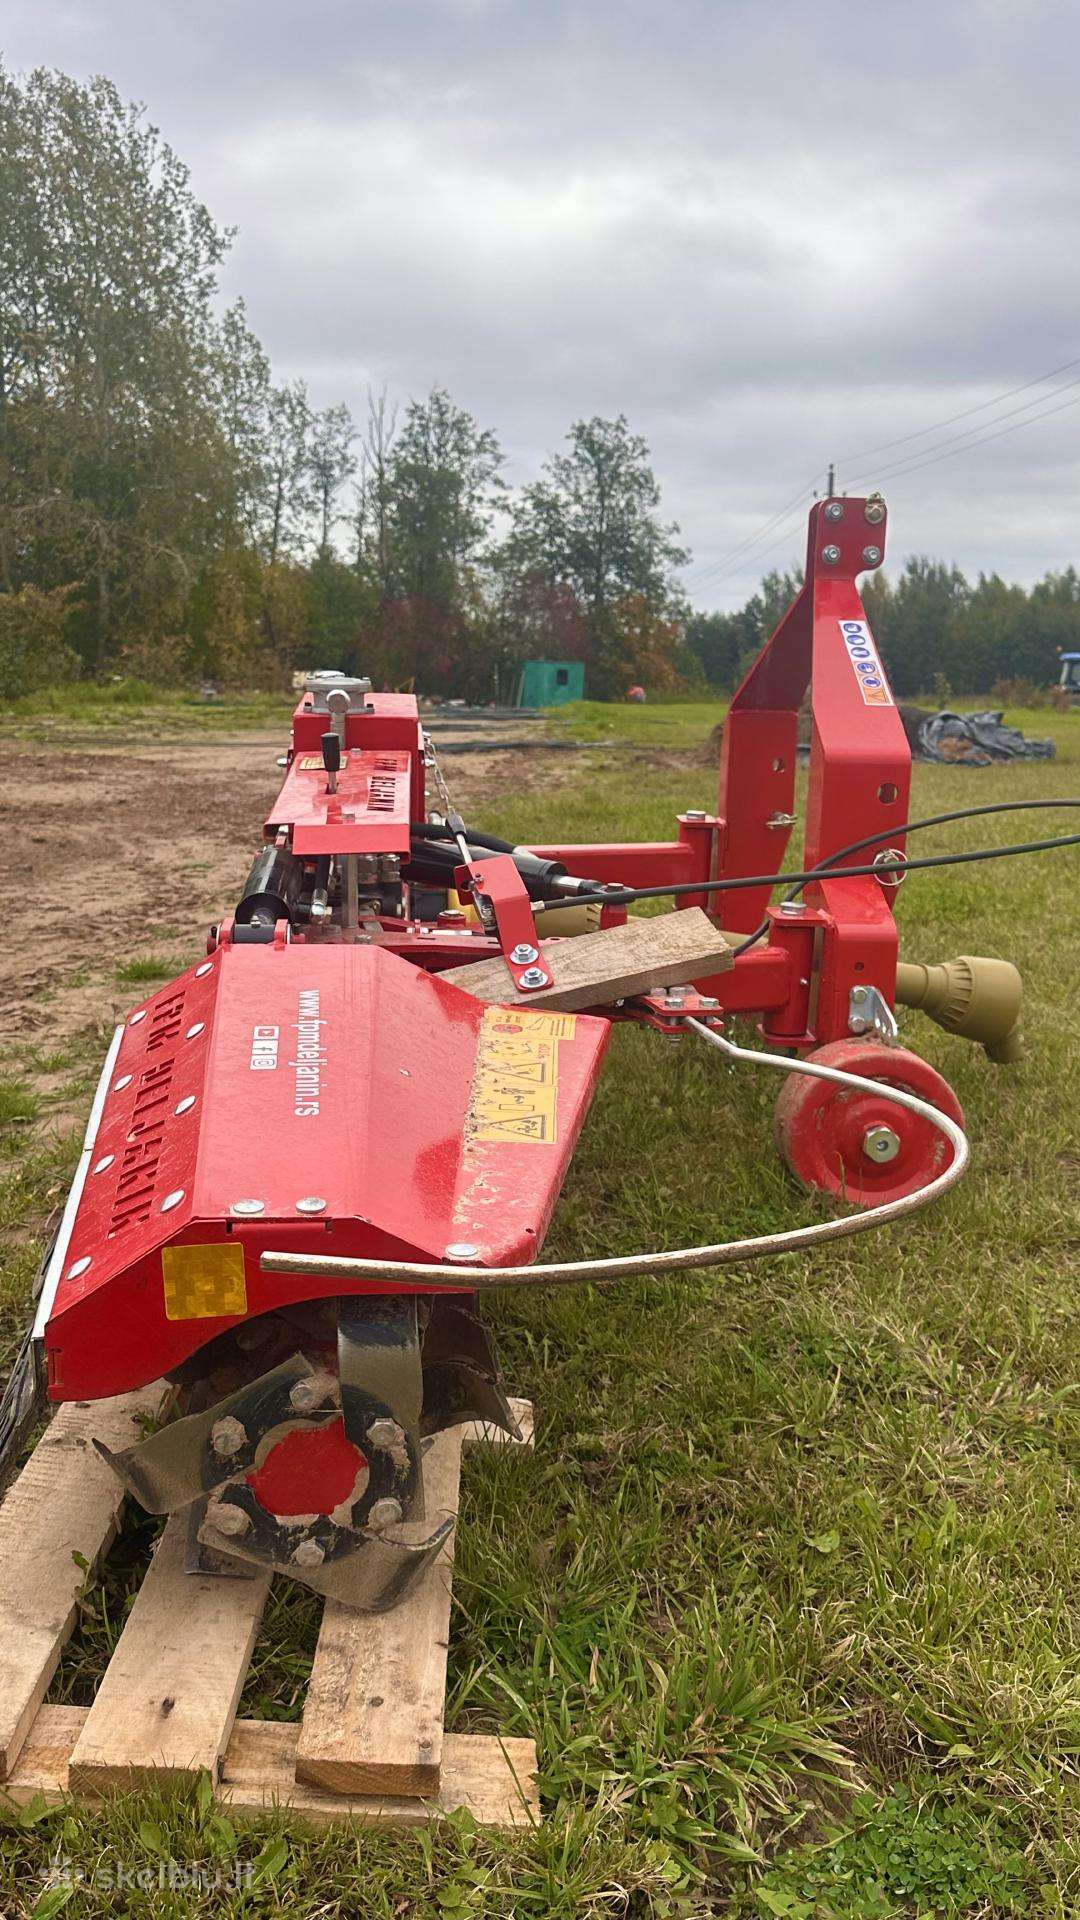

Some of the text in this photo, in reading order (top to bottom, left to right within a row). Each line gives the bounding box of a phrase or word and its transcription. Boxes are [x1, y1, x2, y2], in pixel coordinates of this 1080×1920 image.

[367, 776, 396, 812] DELJANIN
[288, 989, 328, 1117] www.fpmdeljanin.rs
[107, 1058, 176, 1239] DELJANIN
